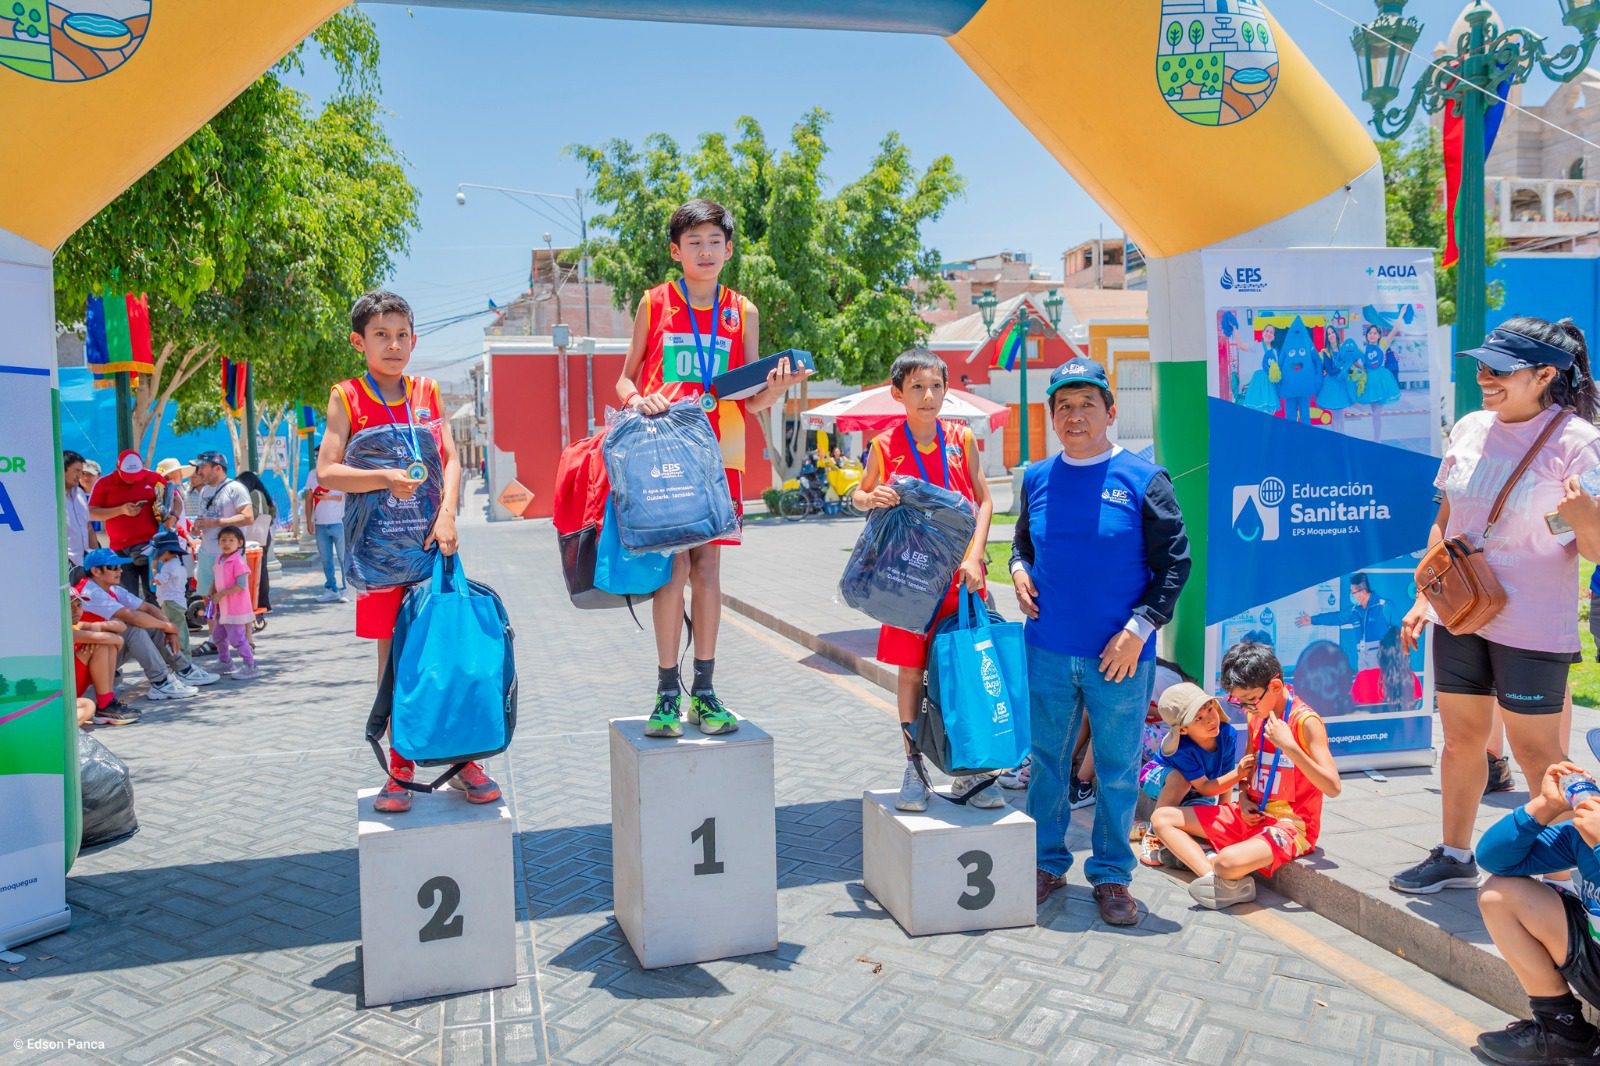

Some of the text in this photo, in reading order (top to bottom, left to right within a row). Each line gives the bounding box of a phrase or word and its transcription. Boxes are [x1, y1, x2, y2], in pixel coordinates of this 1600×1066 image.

[1236, 267, 1262, 283] EPS
[1377, 265, 1417, 278] AGUA
[662, 463, 680, 472] EPS
[1292, 482, 1373, 499] Educación
[1291, 500, 1391, 523] Sanitaria
[1292, 525, 1360, 536] EPS Moquegua S.A.
[912, 551, 929, 563] EPS
[1505, 692, 1532, 700] adidas
[691, 817, 724, 876] 1
[957, 850, 996, 911] 3
[417, 875, 464, 943] 2
